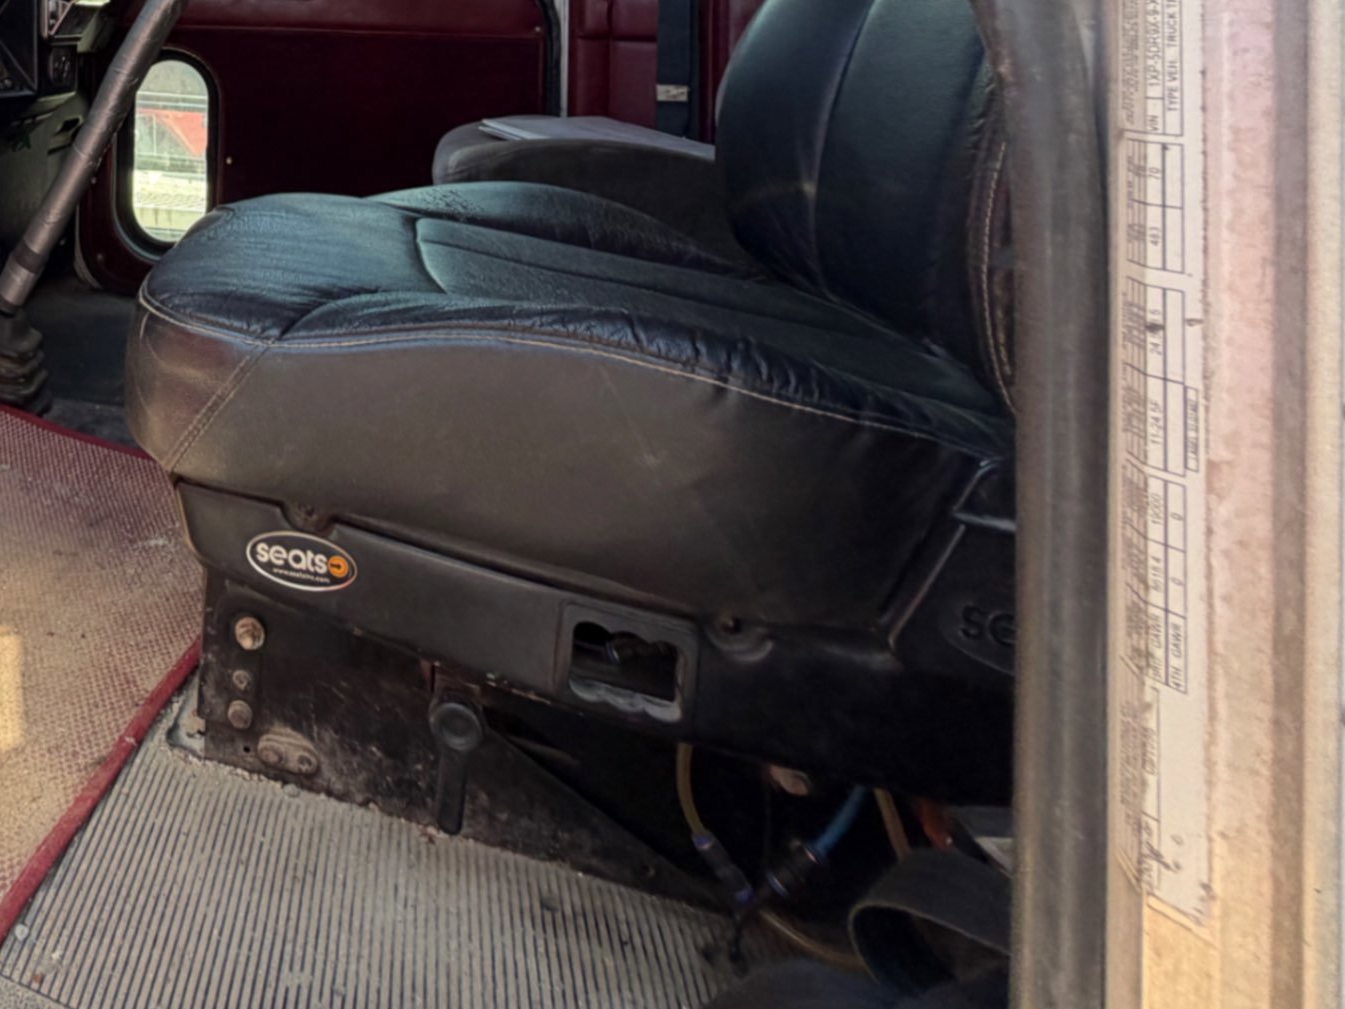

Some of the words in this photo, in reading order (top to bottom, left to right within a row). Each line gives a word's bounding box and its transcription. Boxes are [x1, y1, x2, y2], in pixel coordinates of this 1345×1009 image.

[1166, 13, 1178, 48] TRUCK
[1167, 86, 1179, 113] TYPE
[1147, 115, 1159, 132] VIN
[256, 541, 328, 575] seats
